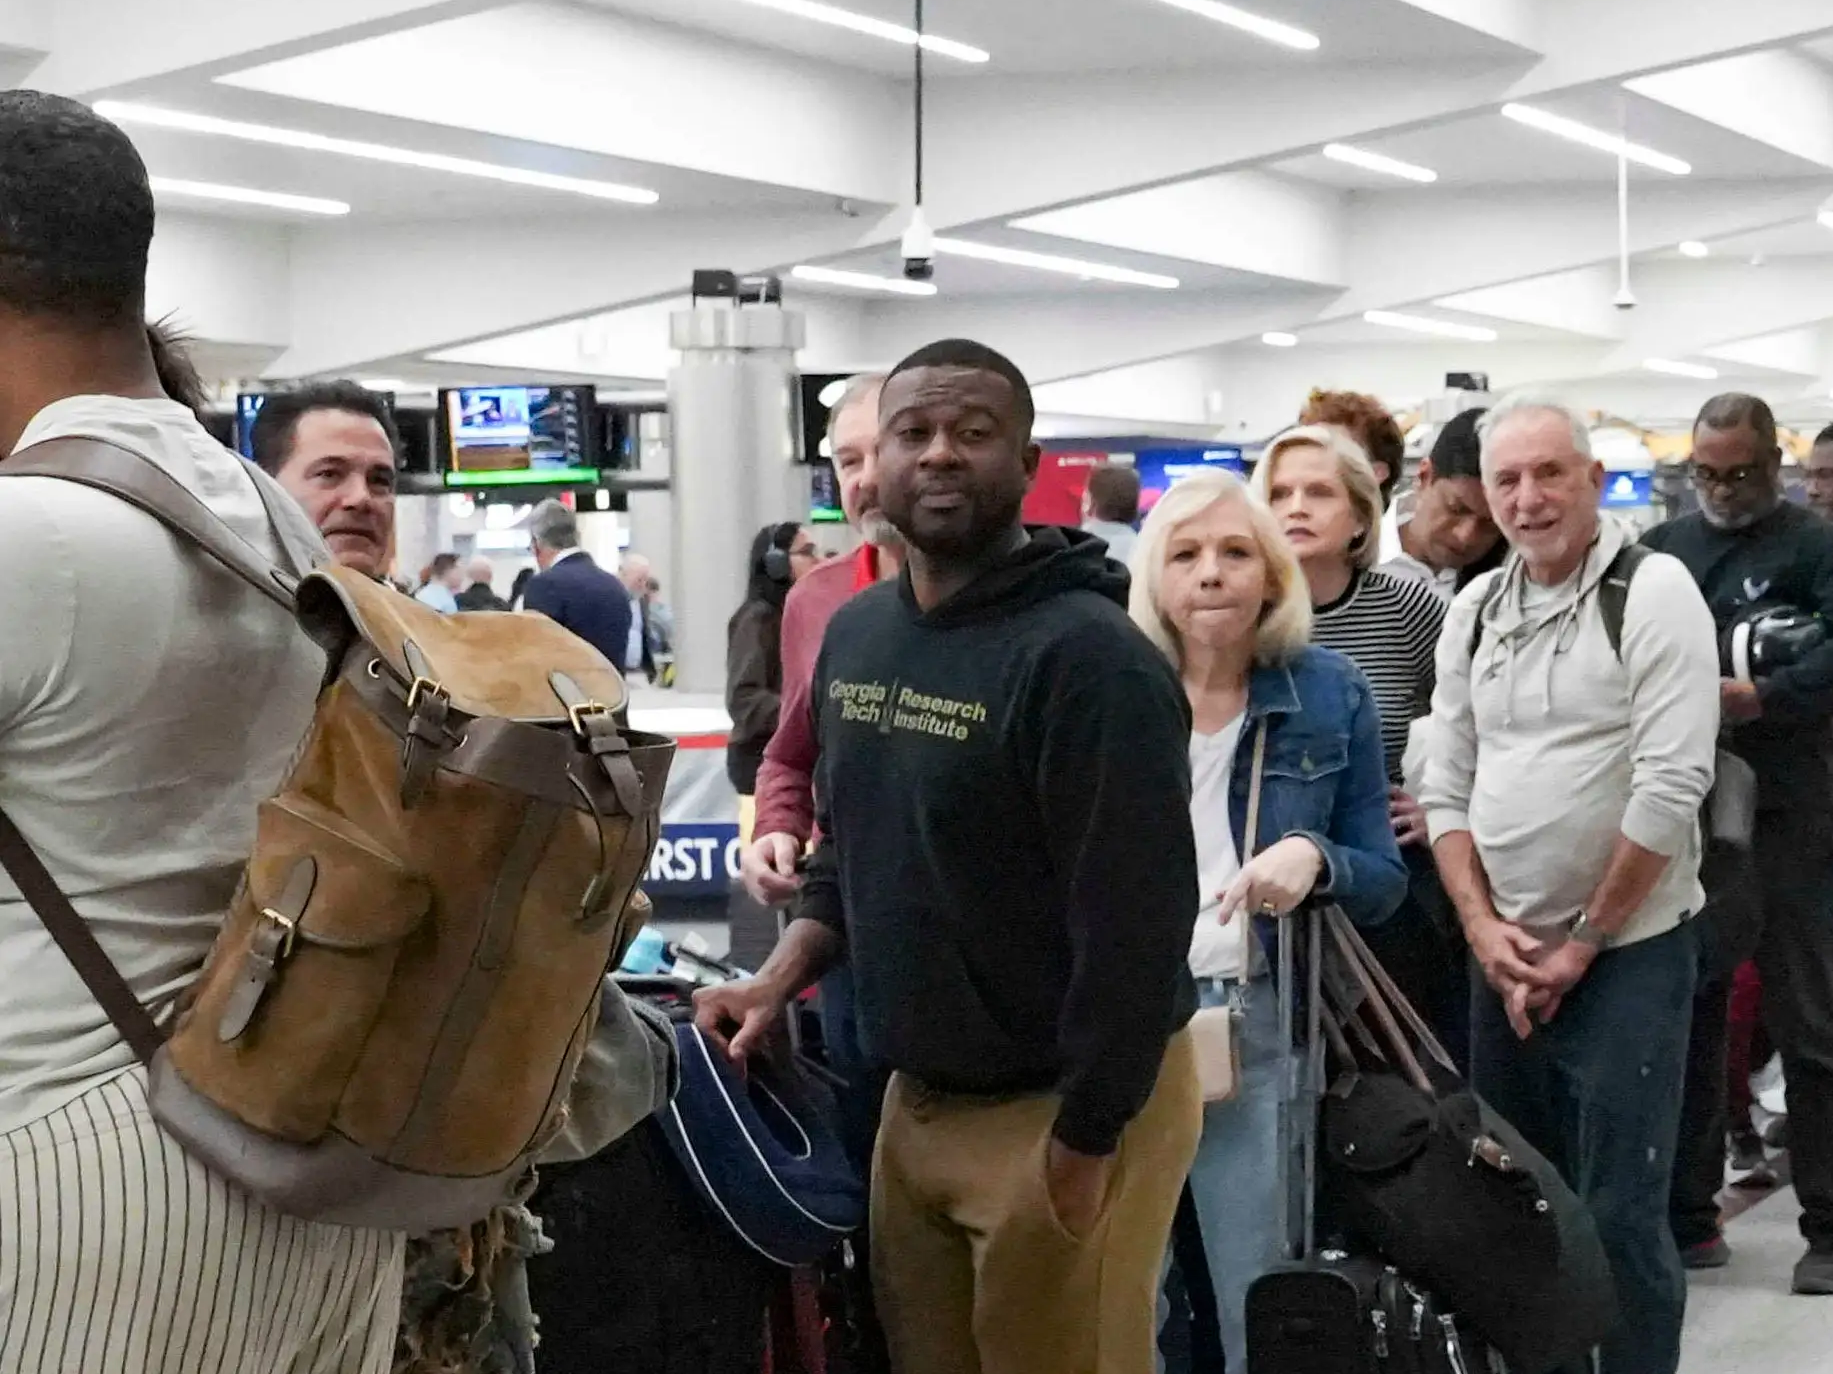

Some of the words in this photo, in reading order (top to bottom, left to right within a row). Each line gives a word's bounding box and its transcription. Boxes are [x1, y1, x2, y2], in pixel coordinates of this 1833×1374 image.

[829, 678, 887, 704] Georgia
[898, 686, 988, 723] Research
[841, 699, 881, 723] Tech
[893, 708, 970, 742] Institute
[643, 837, 719, 882] RST
